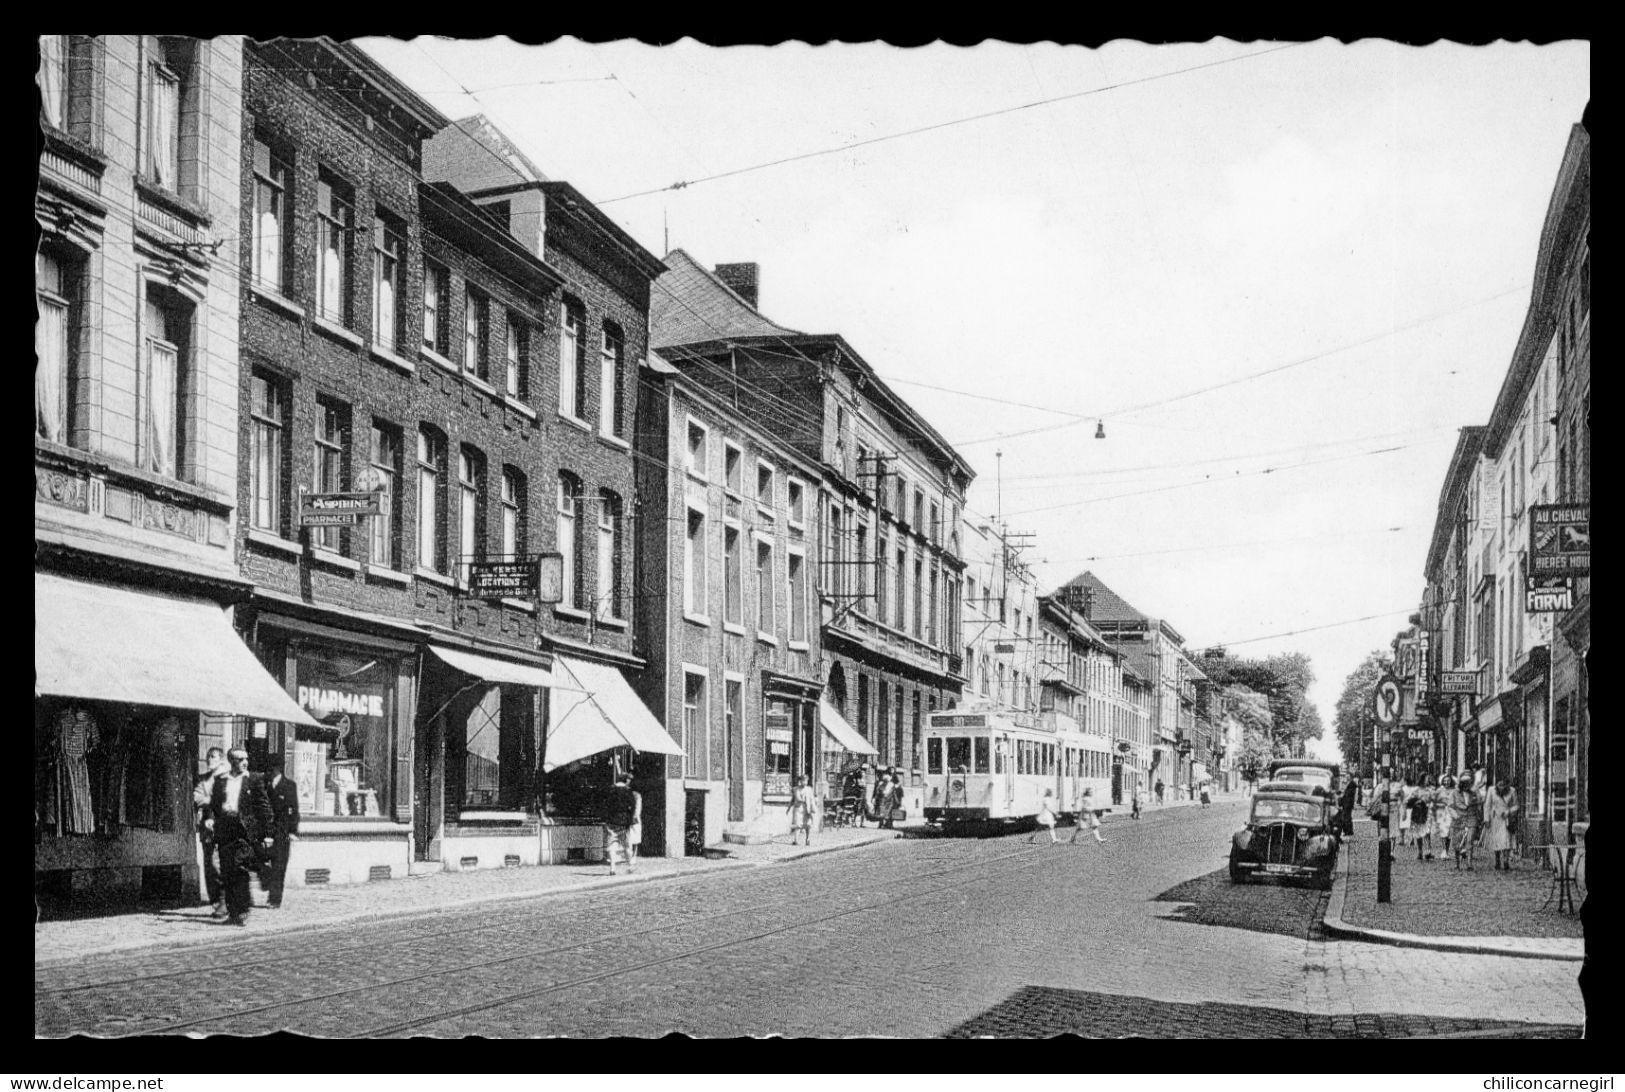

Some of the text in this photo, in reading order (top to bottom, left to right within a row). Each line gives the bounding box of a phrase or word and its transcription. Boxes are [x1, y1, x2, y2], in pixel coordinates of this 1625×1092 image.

[303, 515, 352, 525] PHARMACIE
[1536, 509, 1587, 522] AU CHEVAL
[477, 577, 520, 586] LOCATIONS
[1527, 589, 1573, 611] FORVIL
[298, 686, 384, 717] PHARMACIE
[1408, 728, 1434, 739] GLACES
